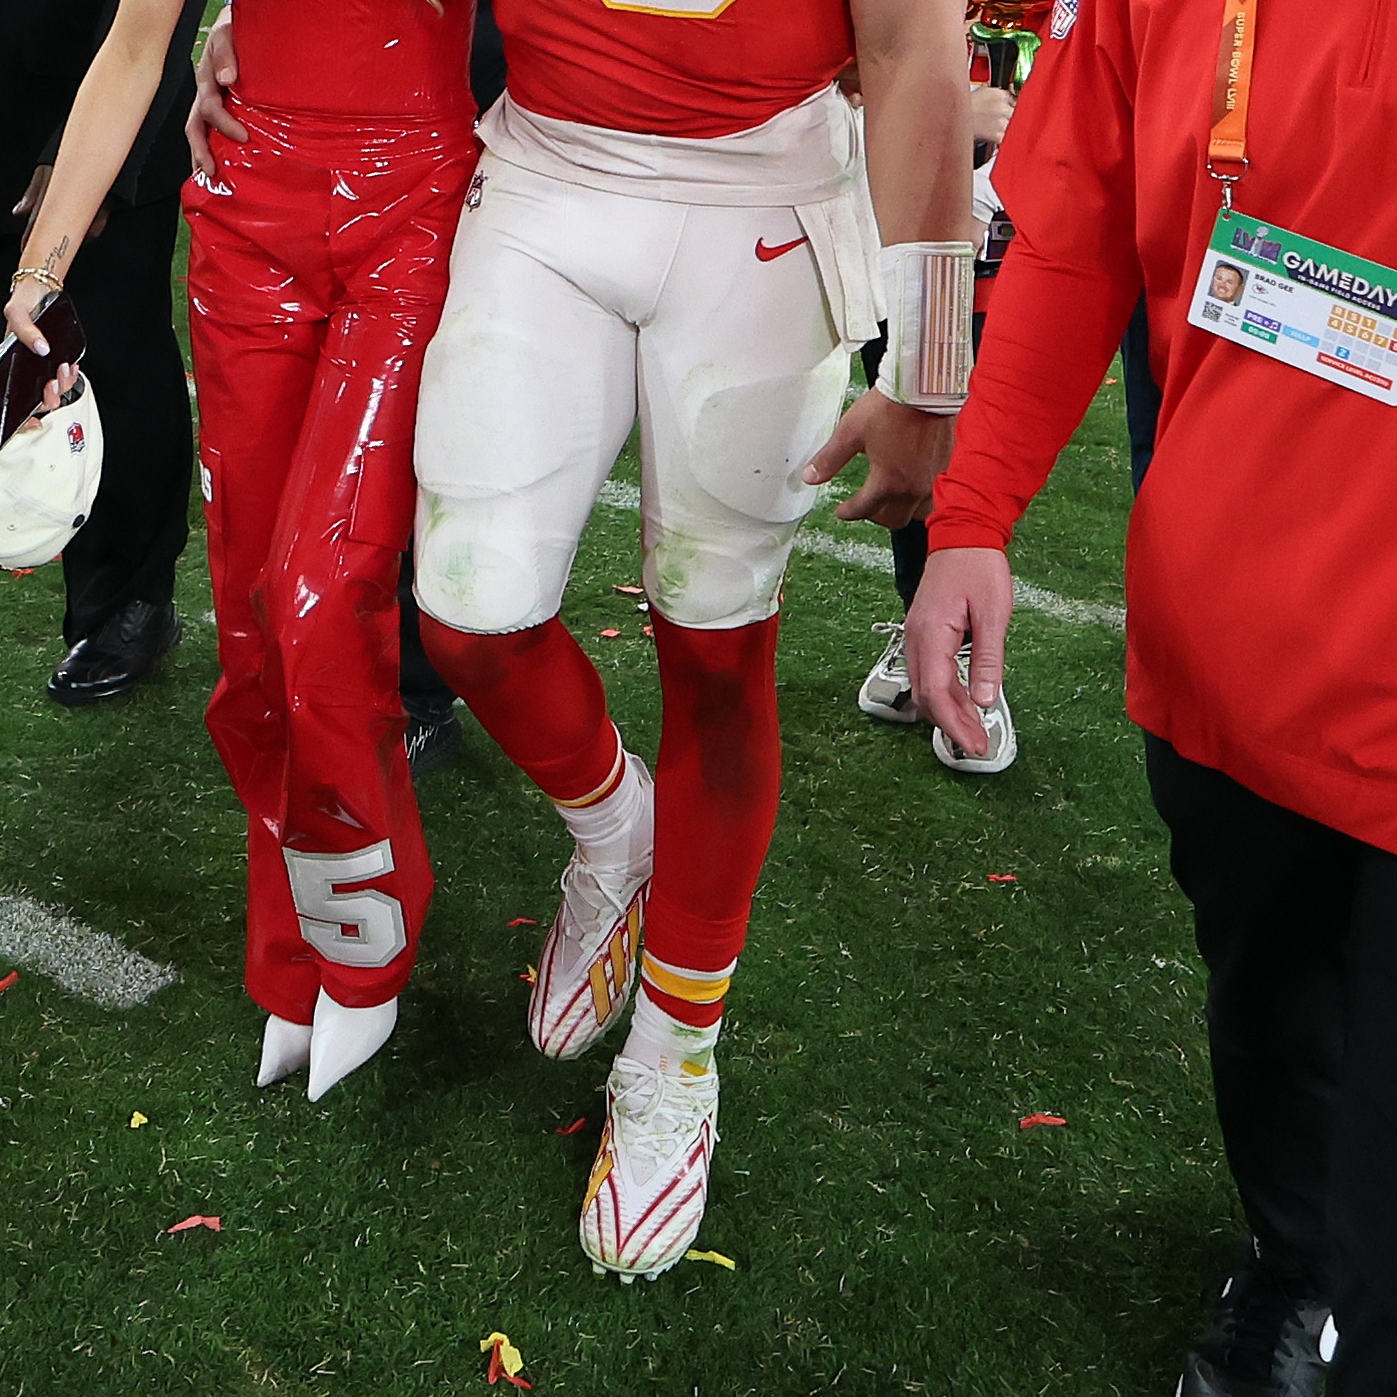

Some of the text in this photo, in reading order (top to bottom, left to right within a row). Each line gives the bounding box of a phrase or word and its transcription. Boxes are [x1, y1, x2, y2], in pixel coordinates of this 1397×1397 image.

[1233, 11, 1247, 47] SUPER
[1229, 51, 1243, 85] BOWL
[1255, 273, 1295, 294] BRAD GEE
[1297, 275, 1382, 311] IN-GAME FIELD ACCESS
[283, 838, 407, 968] 5
